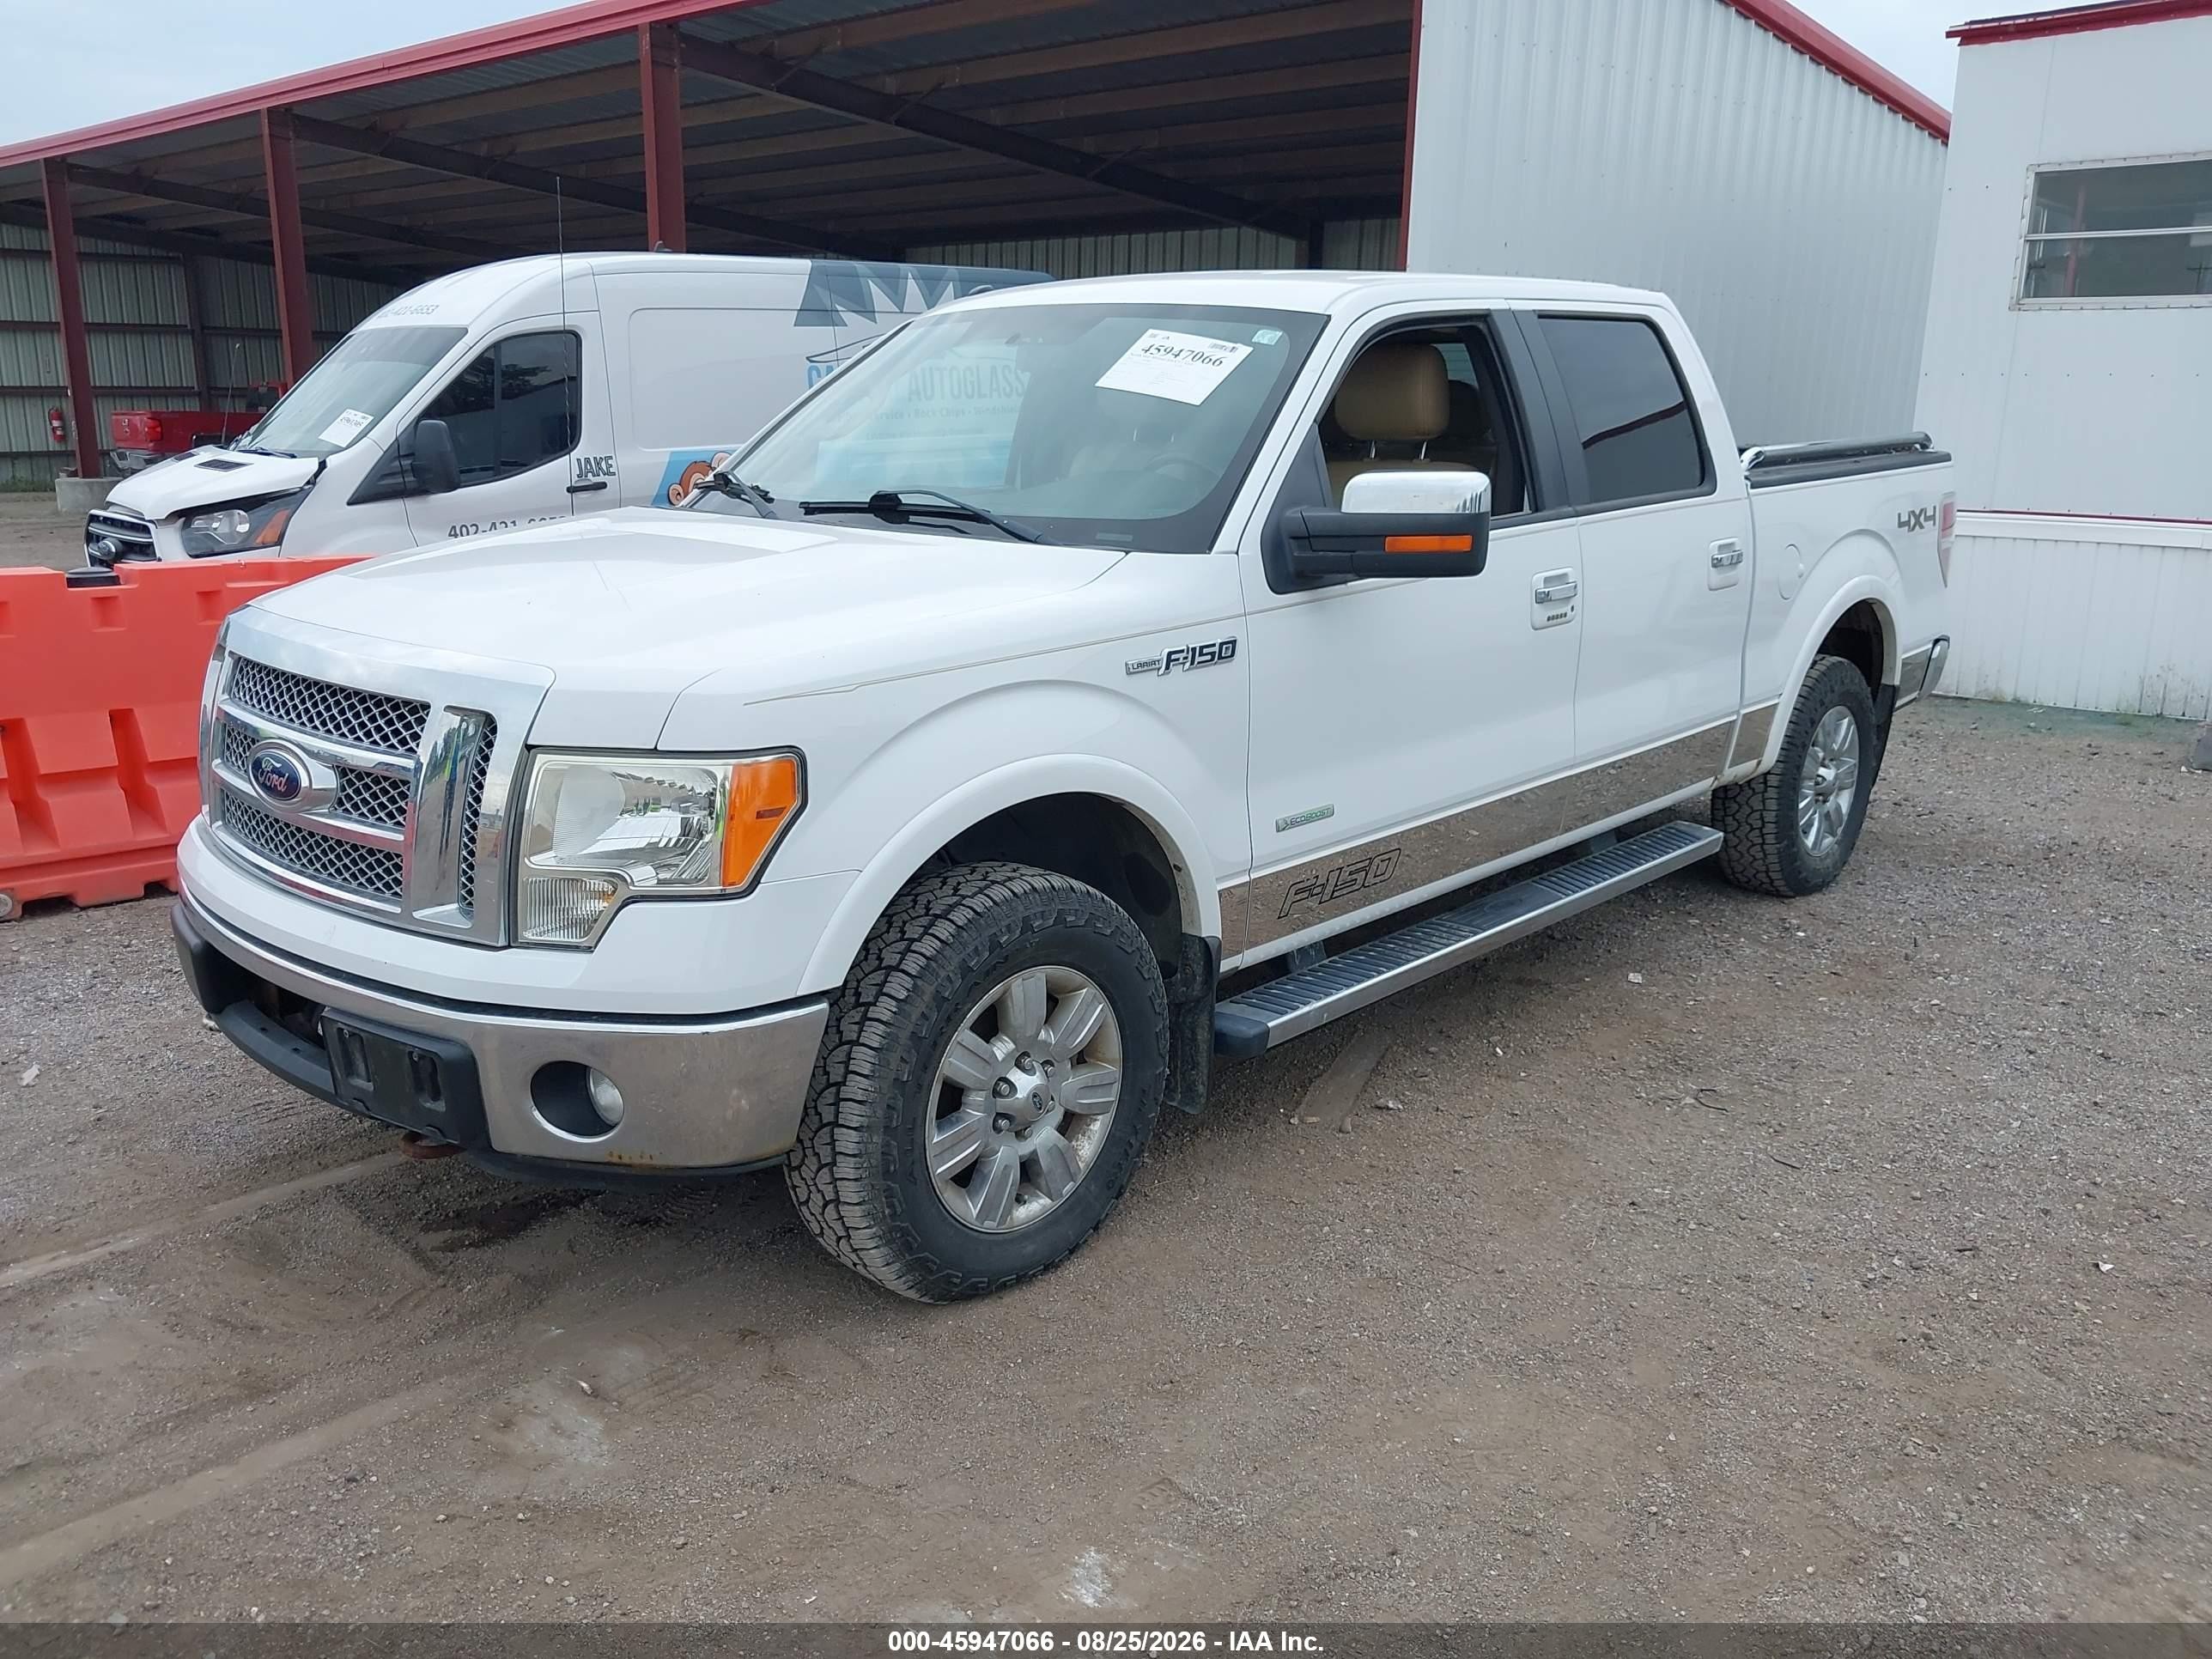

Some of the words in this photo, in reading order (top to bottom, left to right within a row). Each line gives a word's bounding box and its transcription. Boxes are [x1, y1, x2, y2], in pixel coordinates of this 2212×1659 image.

[1141, 343, 1227, 367] 45947066
[908, 364, 1024, 403] AUTOGLASS
[576, 456, 617, 478] JAKE
[1897, 505, 1936, 532] 4X4
[1131, 659, 1161, 670] LARIAT
[1163, 638, 1237, 672] F-150
[258, 757, 289, 793] Ford
[1277, 848, 1401, 920] F-150
